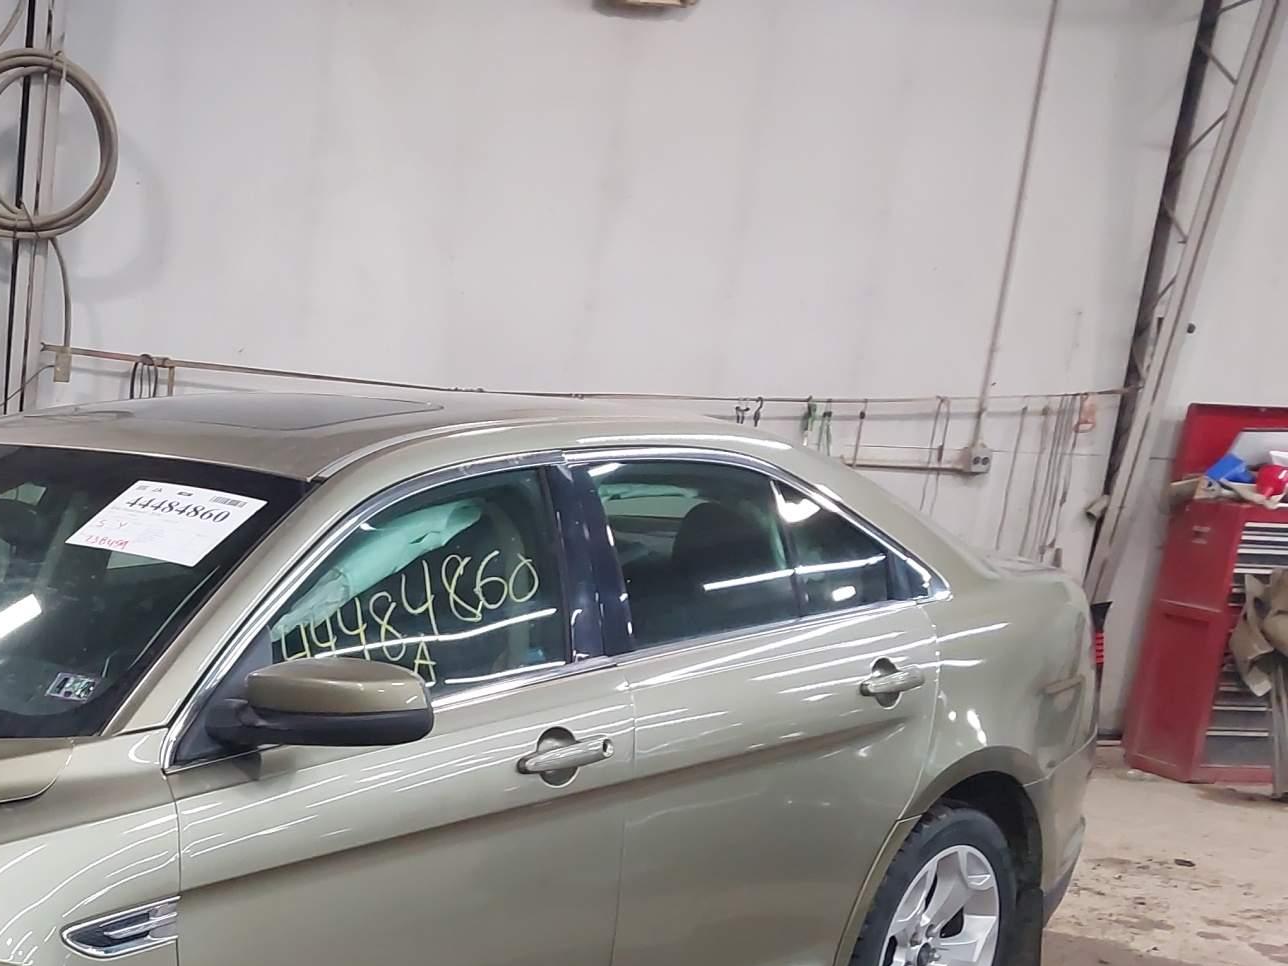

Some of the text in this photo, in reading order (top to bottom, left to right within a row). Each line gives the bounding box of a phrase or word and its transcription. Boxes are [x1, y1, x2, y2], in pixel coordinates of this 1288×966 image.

[126, 496, 231, 523] 44484860
[281, 550, 539, 661] 44484860
[413, 634, 437, 687] A
